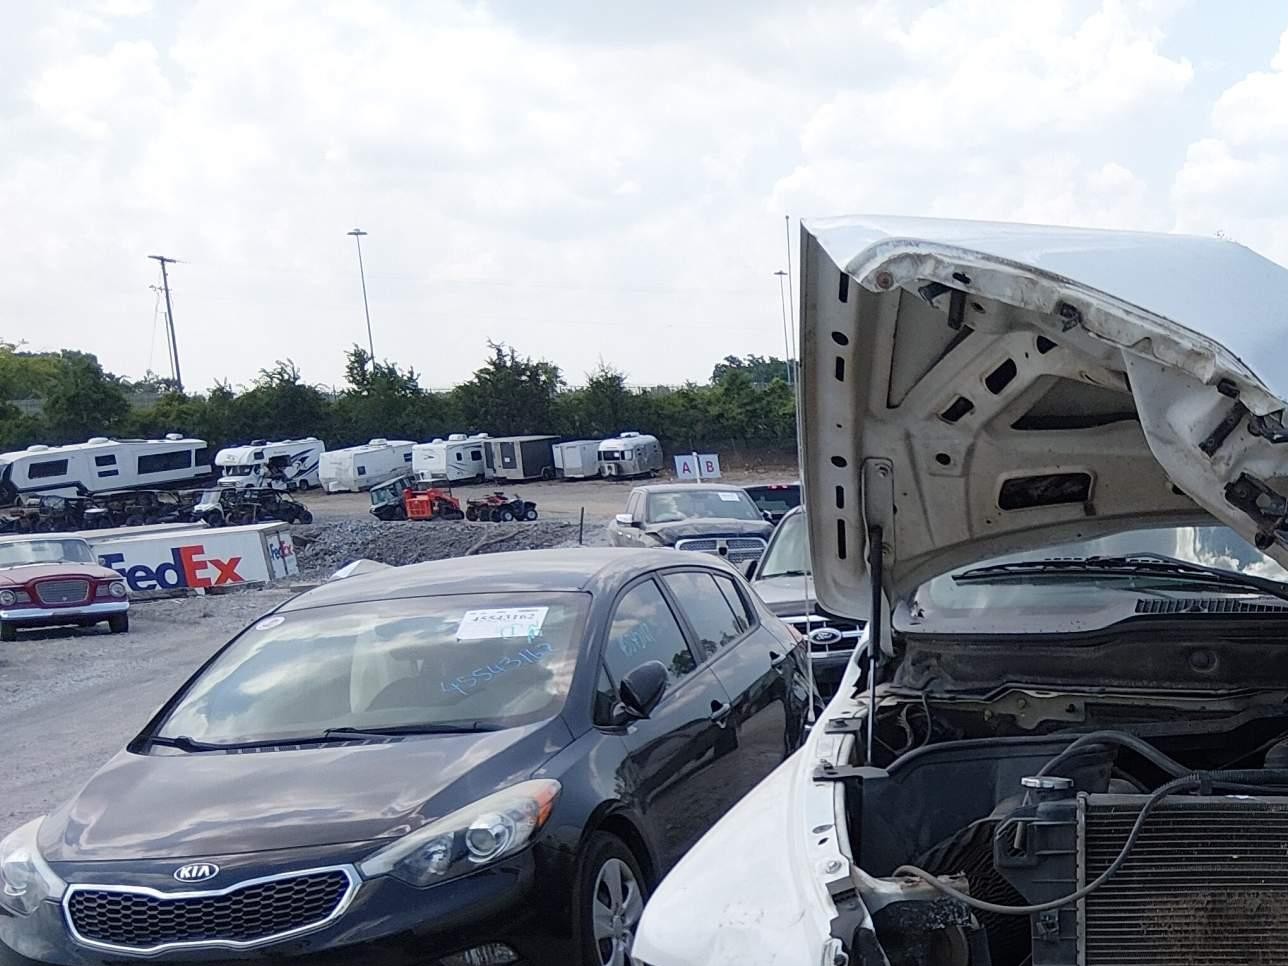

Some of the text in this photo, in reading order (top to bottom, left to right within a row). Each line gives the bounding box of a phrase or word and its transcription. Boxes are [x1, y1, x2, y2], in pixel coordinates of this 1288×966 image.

[682, 461, 692, 474] A
[705, 460, 715, 473] B
[98, 545, 245, 592] FedEx
[180, 865, 210, 878] KIA
